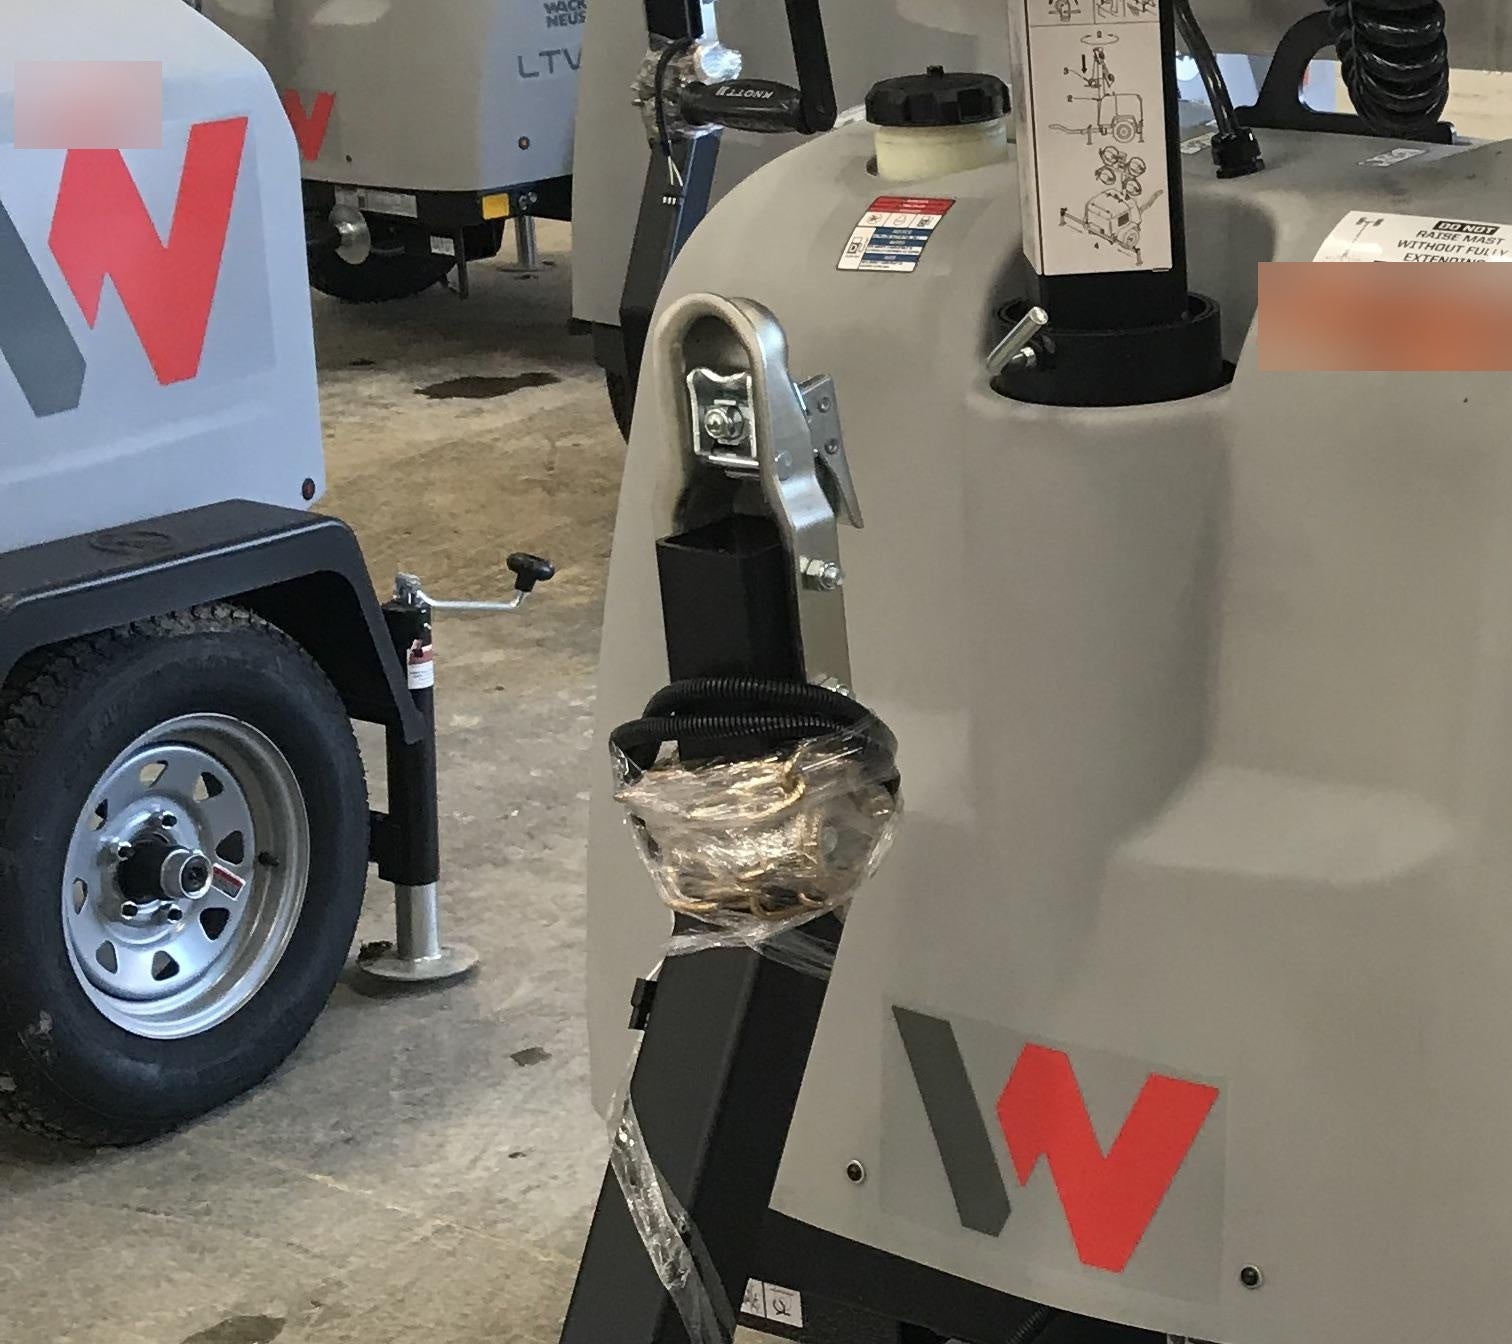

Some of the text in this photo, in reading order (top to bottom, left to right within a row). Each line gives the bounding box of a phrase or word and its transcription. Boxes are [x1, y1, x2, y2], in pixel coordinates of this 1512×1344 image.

[726, 89, 773, 99] KNOTT
[1438, 222, 1497, 233] DO NOT
[1416, 230, 1505, 245] RAISE MAST
[1397, 240, 1464, 252] WITHOUT
[1403, 252, 1487, 262] EXTENDI
